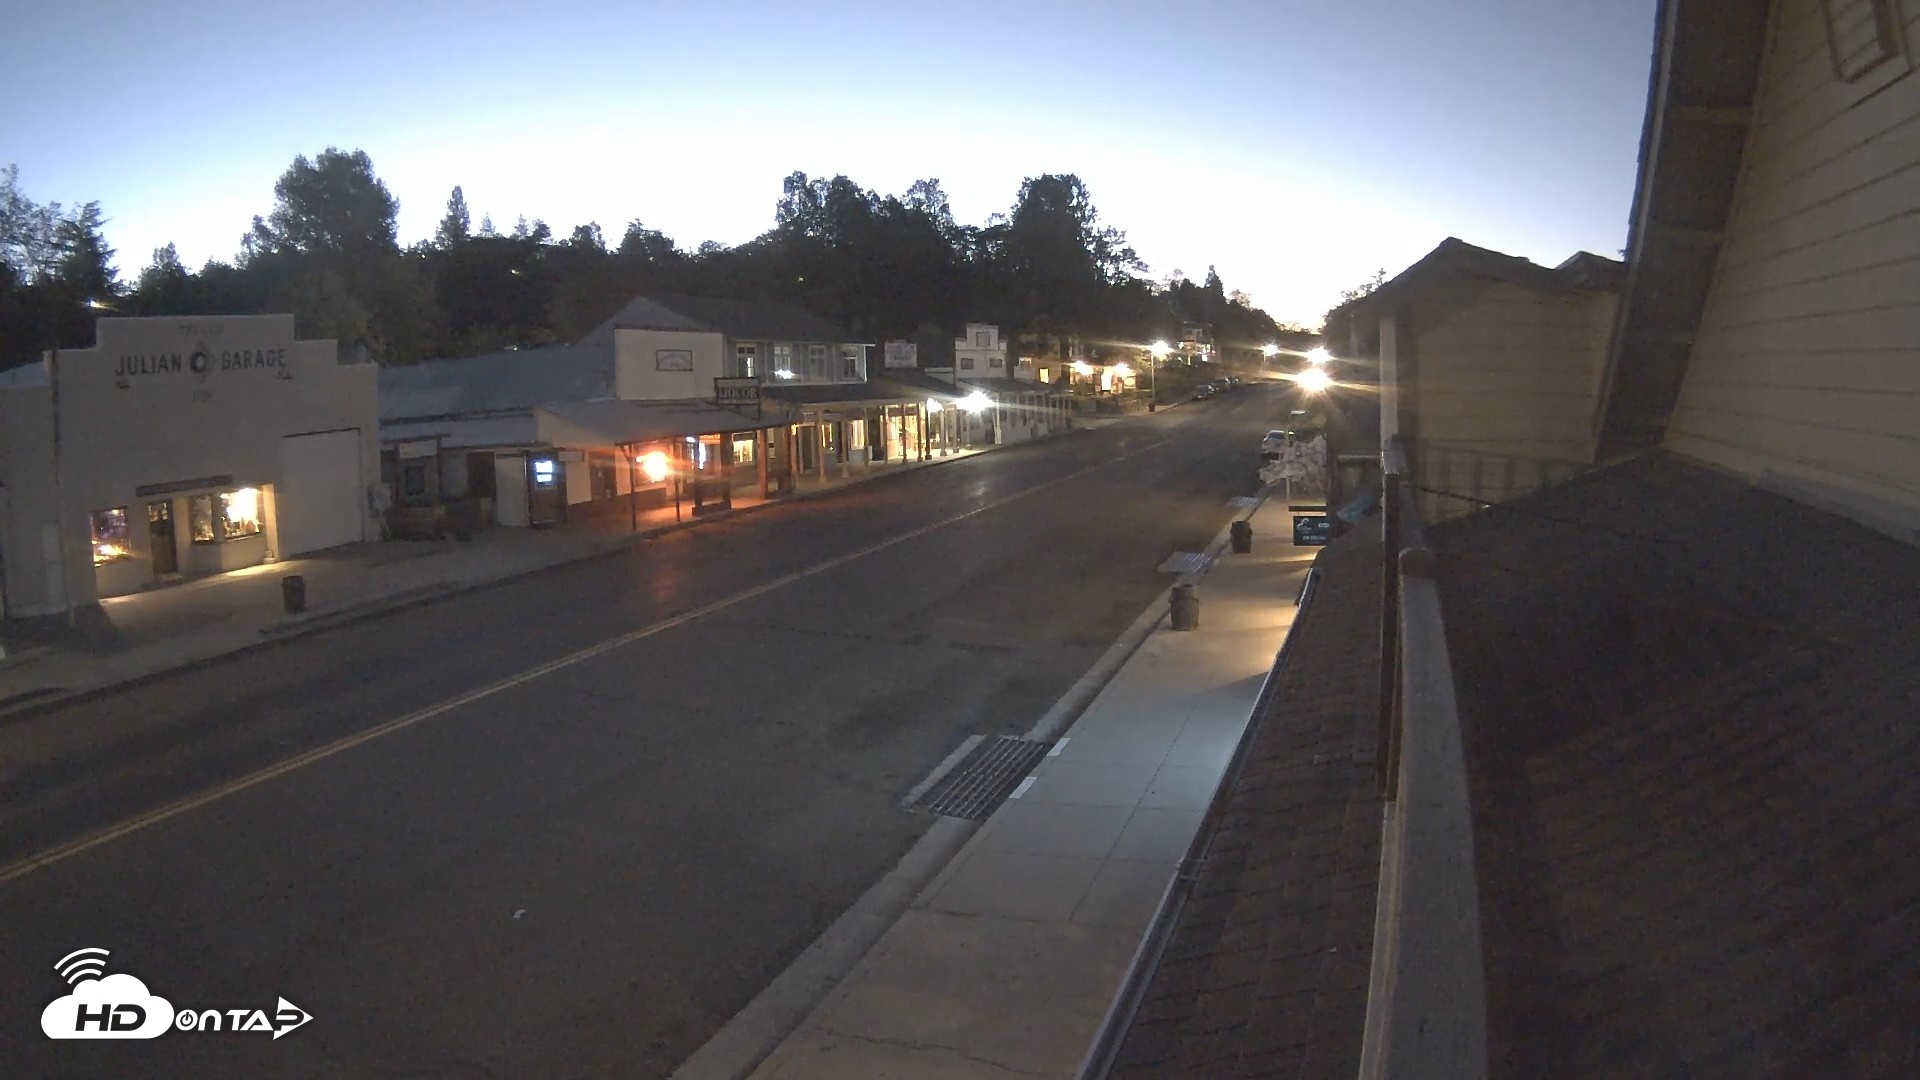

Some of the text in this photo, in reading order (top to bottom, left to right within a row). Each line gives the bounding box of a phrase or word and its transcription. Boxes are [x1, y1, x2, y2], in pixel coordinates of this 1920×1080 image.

[114, 349, 288, 376] JULIAN GARAGE
[718, 386, 759, 400] LIQUOR
